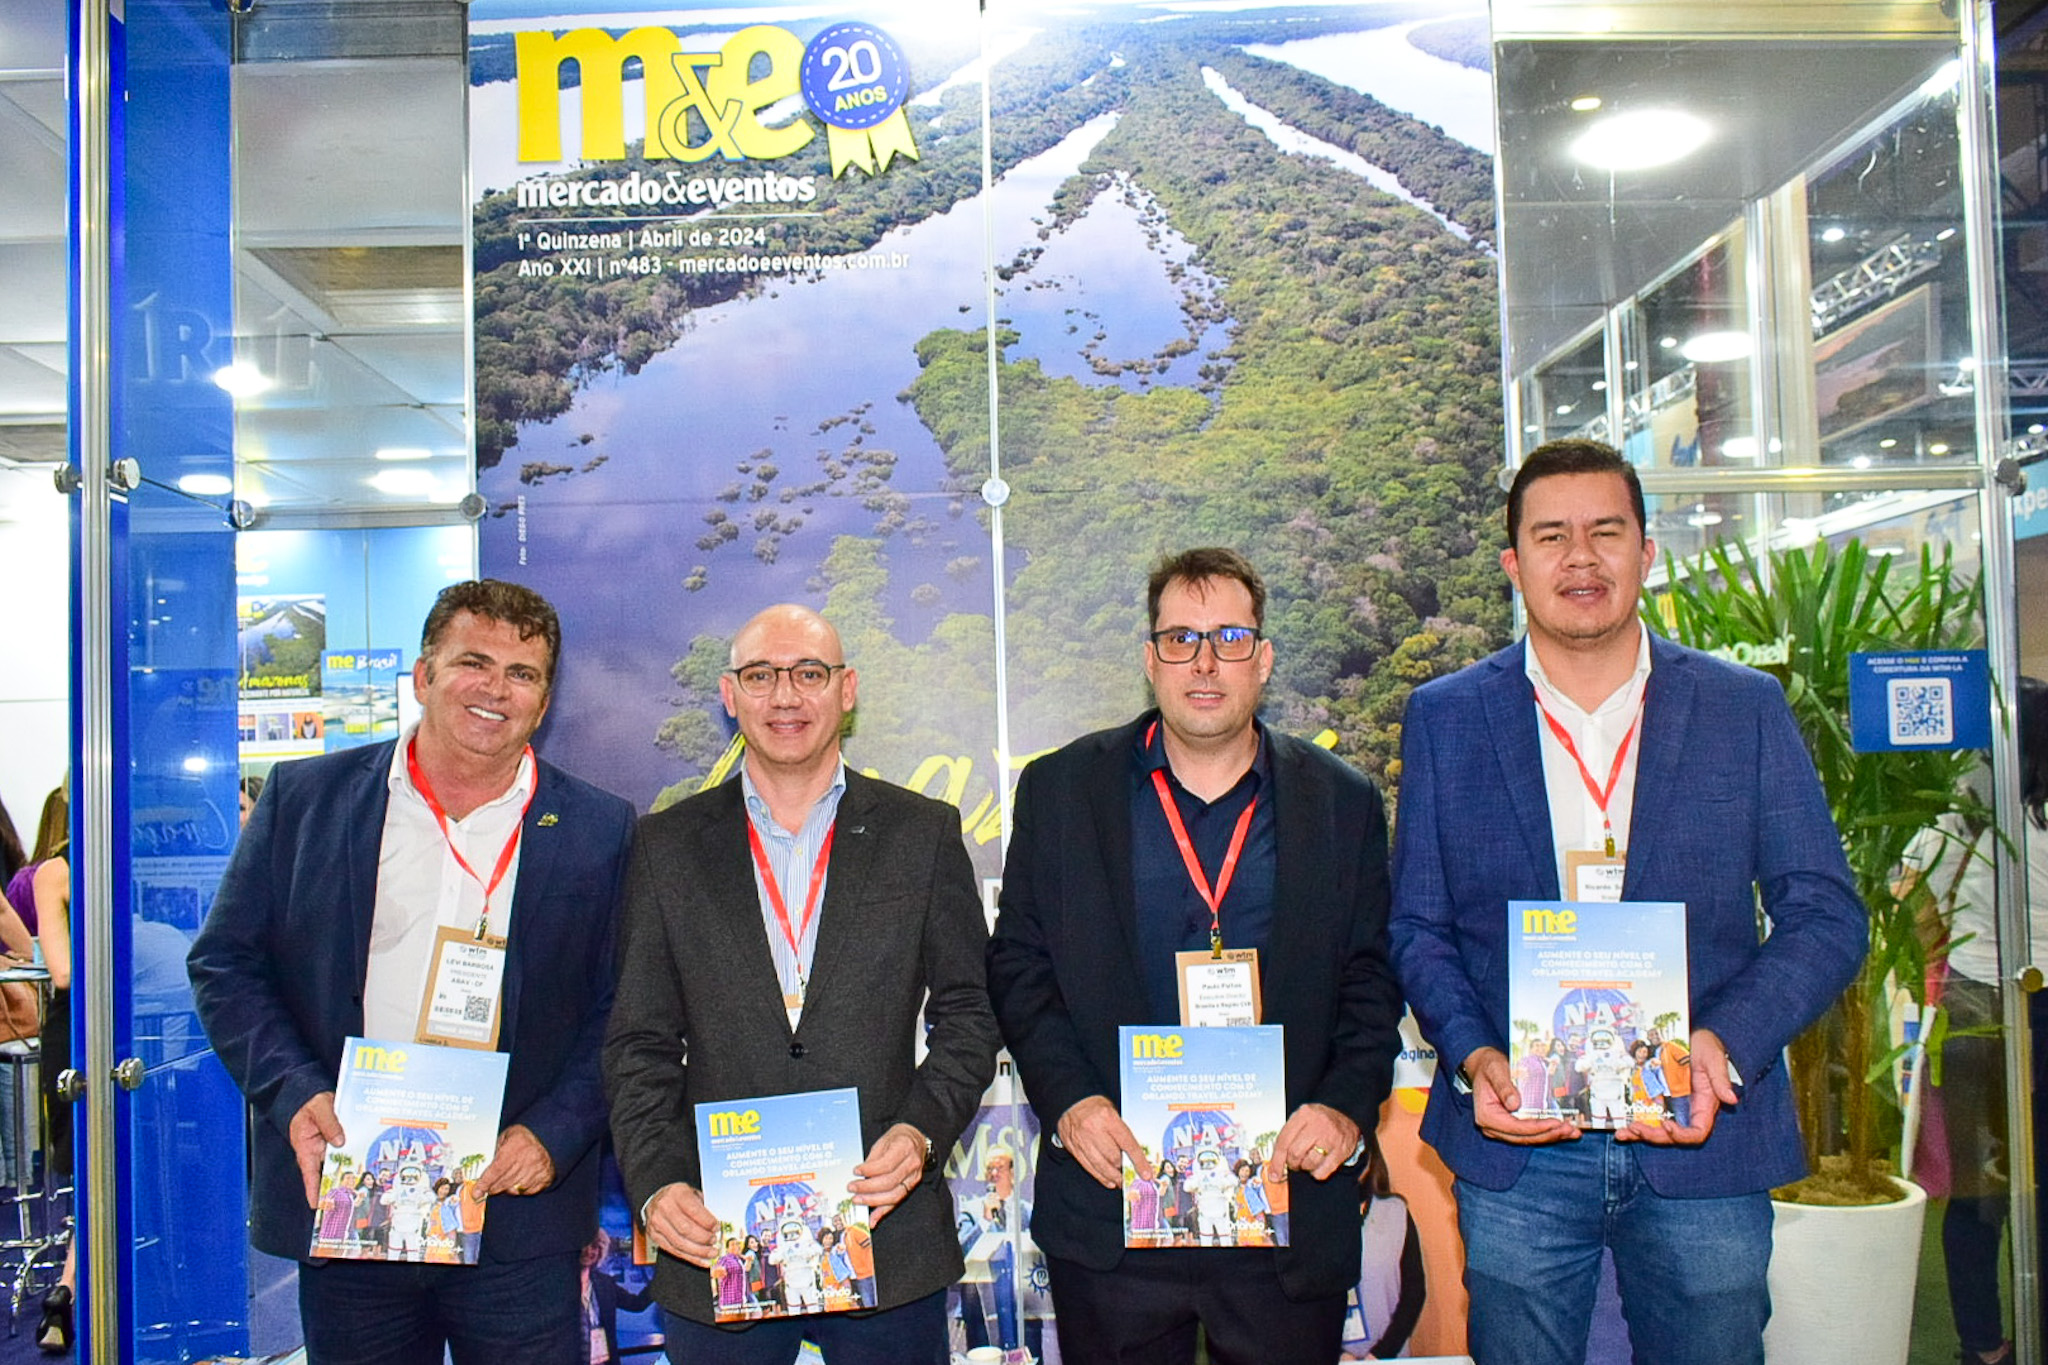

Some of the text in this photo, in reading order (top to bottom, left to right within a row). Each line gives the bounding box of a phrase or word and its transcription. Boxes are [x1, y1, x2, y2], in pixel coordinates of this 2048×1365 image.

[821, 40, 882, 91] 20
[834, 86, 887, 112] ANOS
[517, 172, 817, 208] mercado&eventos
[537, 232, 621, 252] Quinzena
[640, 229, 683, 248] Abril
[688, 228, 714, 247] de
[719, 228, 766, 248] 2024
[517, 261, 554, 278] Ano
[560, 260, 590, 275] XXI
[679, 254, 911, 275] mercadoeeventos.com.br
[357, 654, 398, 671] Brasil
